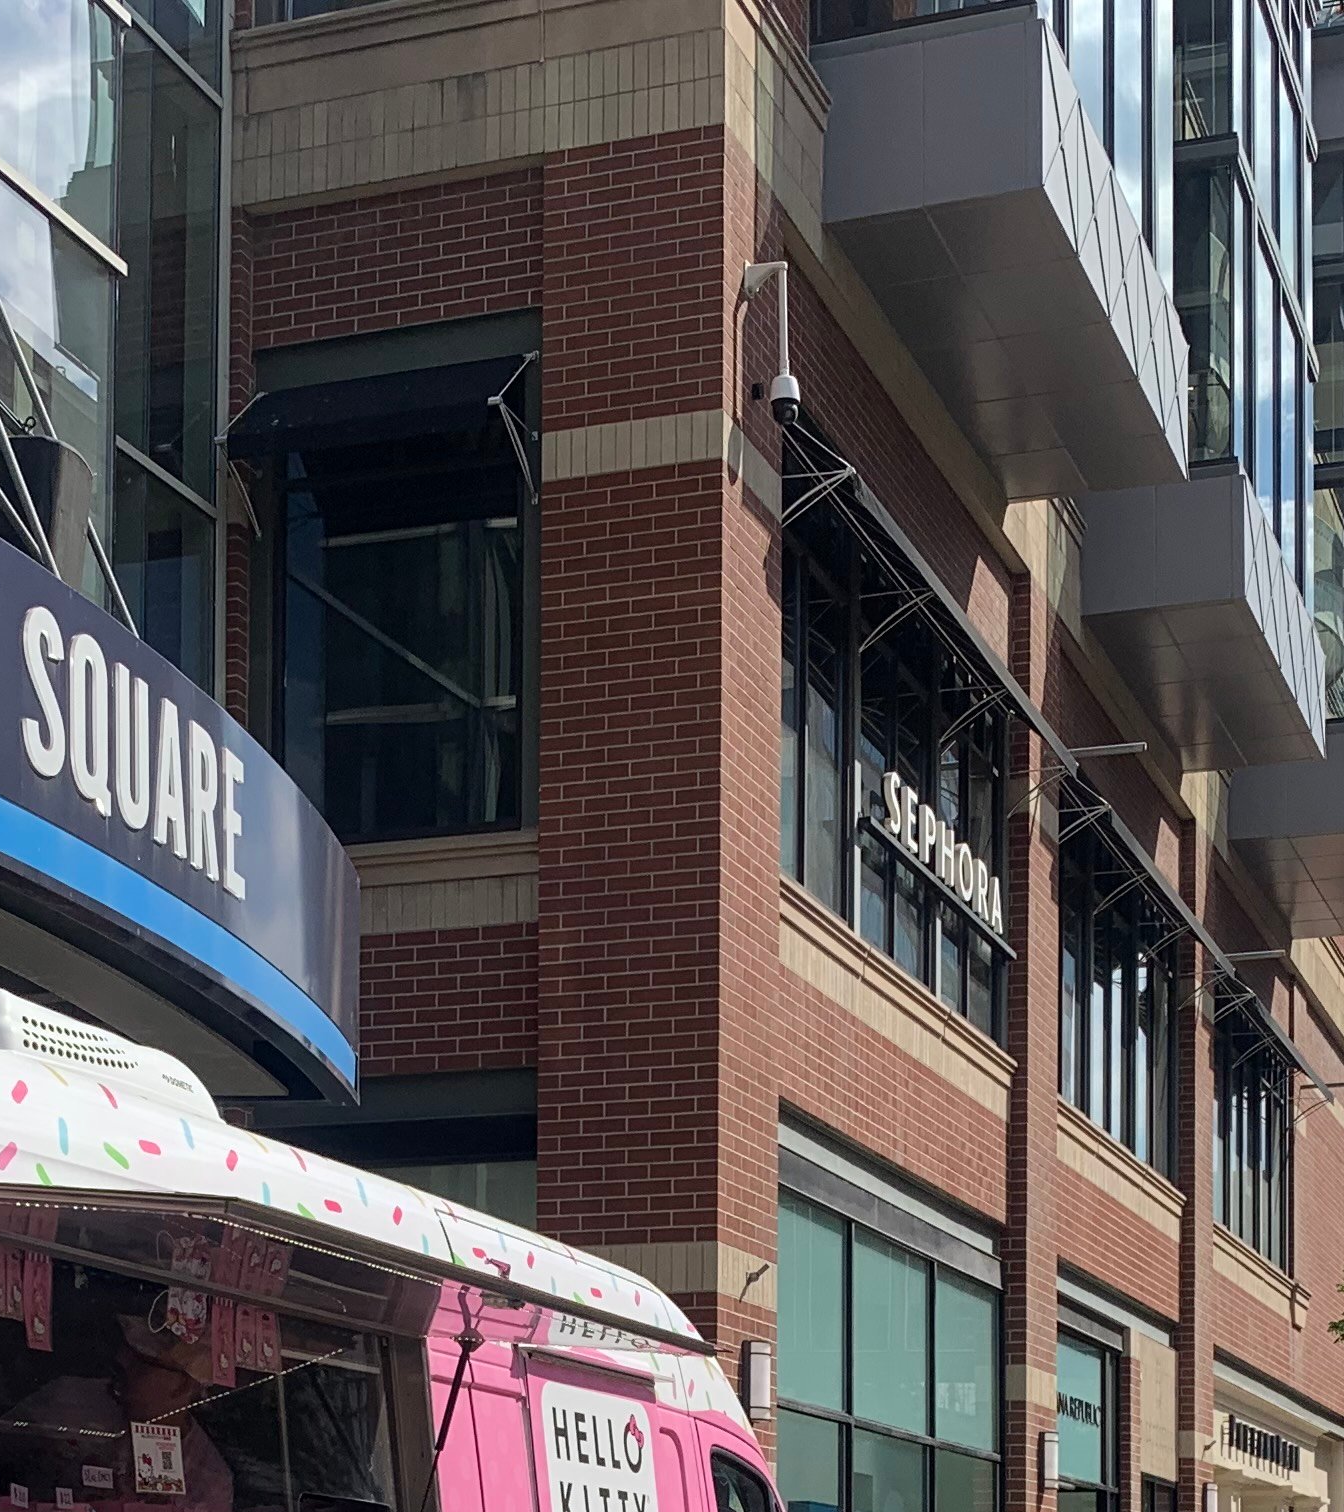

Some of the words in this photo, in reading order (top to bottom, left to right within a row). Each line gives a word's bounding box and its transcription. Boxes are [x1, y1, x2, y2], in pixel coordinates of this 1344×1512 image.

[19, 606, 247, 900] SQUARE
[883, 771, 1004, 935] SEPHORA
[552, 1405, 644, 1474] HELLO
